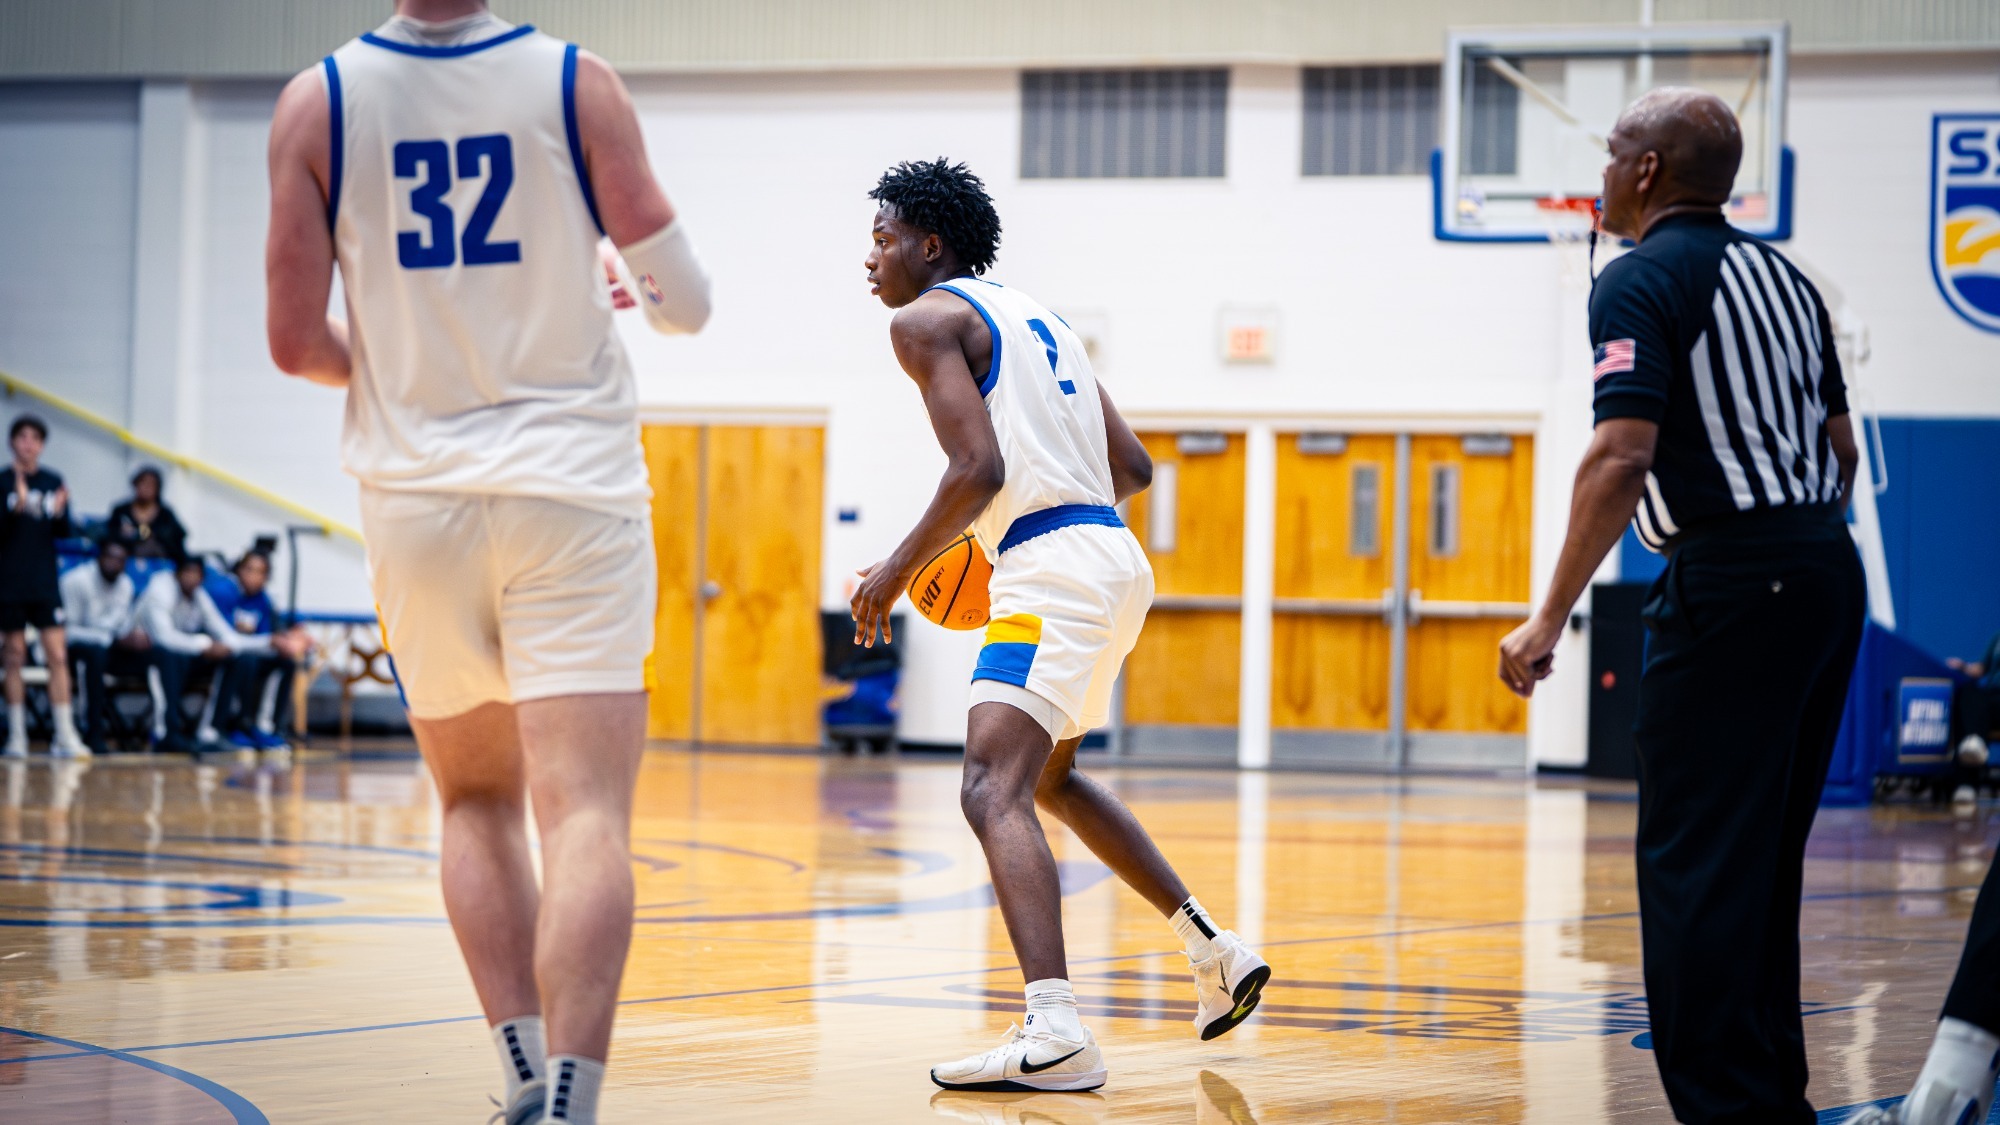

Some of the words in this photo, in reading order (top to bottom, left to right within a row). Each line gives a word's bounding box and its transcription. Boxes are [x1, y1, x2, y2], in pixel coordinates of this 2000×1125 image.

[1948, 129, 2000, 176] S
[393, 132, 522, 269] 32
[1025, 318, 1077, 396] 2
[919, 579, 941, 615] EVO
[935, 566, 945, 581] NXT
